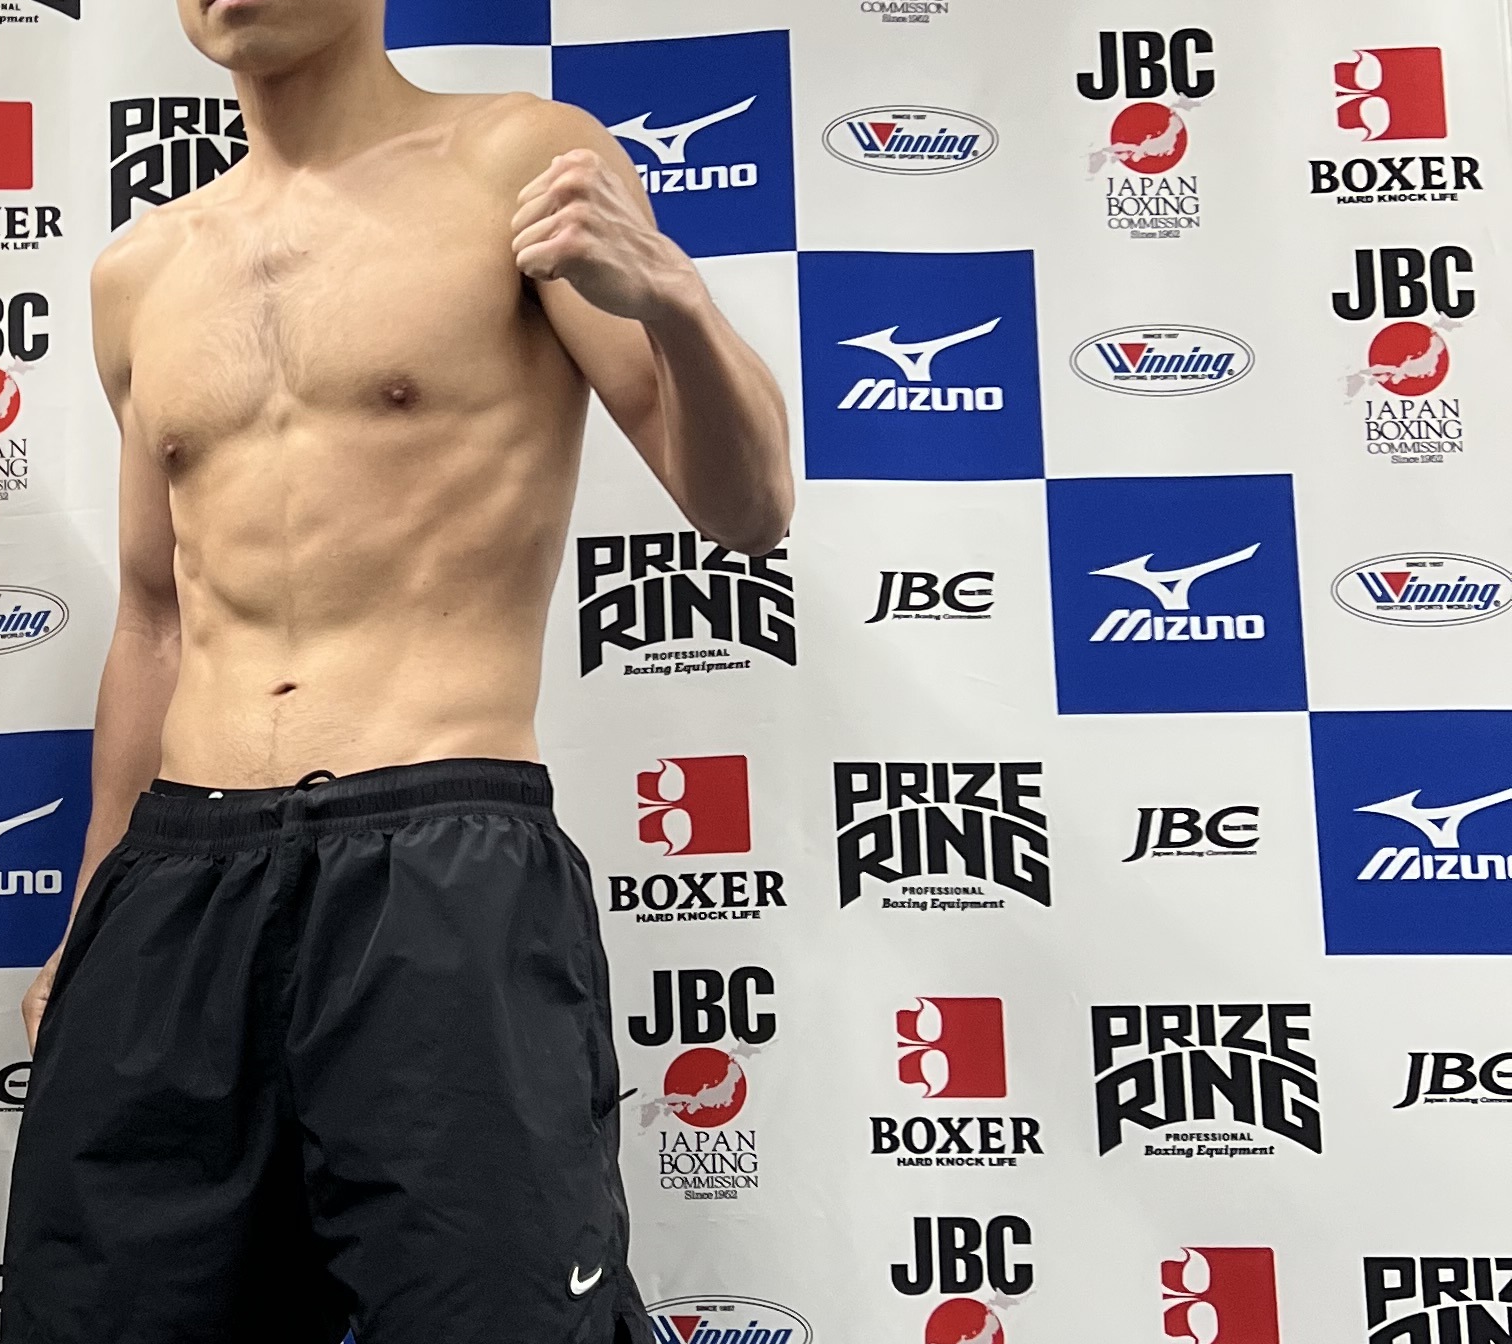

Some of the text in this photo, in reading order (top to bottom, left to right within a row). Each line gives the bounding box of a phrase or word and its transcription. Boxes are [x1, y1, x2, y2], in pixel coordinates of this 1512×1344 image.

[1077, 28, 1214, 100] JBC
[847, 124, 976, 158] Winning
[1309, 157, 1483, 194] BOXER
[1332, 246, 1475, 320] JBC
[838, 379, 1003, 410] MIZUNO
[1365, 399, 1459, 420] JAPAN
[1365, 420, 1462, 440] BOXING
[1367, 441, 1463, 454] COMMISSION
[865, 571, 994, 623] JBC
[579, 574, 796, 677] RING
[1090, 609, 1264, 641] MIZUNO
[624, 660, 750, 675] Boxing Equipment
[645, 649, 730, 661] PROFESSIONAL
[833, 762, 1047, 831] PRIZE
[1122, 806, 1259, 862] JBC
[837, 807, 1051, 908] RING
[1356, 846, 1512, 880] MIZUN
[608, 871, 787, 911] BOXER
[636, 910, 761, 923] HARD KNOCK LIFE
[628, 966, 776, 1046] JBC
[1091, 1004, 1316, 1076] PRIZE
[1095, 1050, 1322, 1156] RING
[869, 1117, 1044, 1154] BOXER
[897, 1157, 1017, 1166] HARD KNOCK LIFE
[891, 1215, 1033, 1295] JBC
